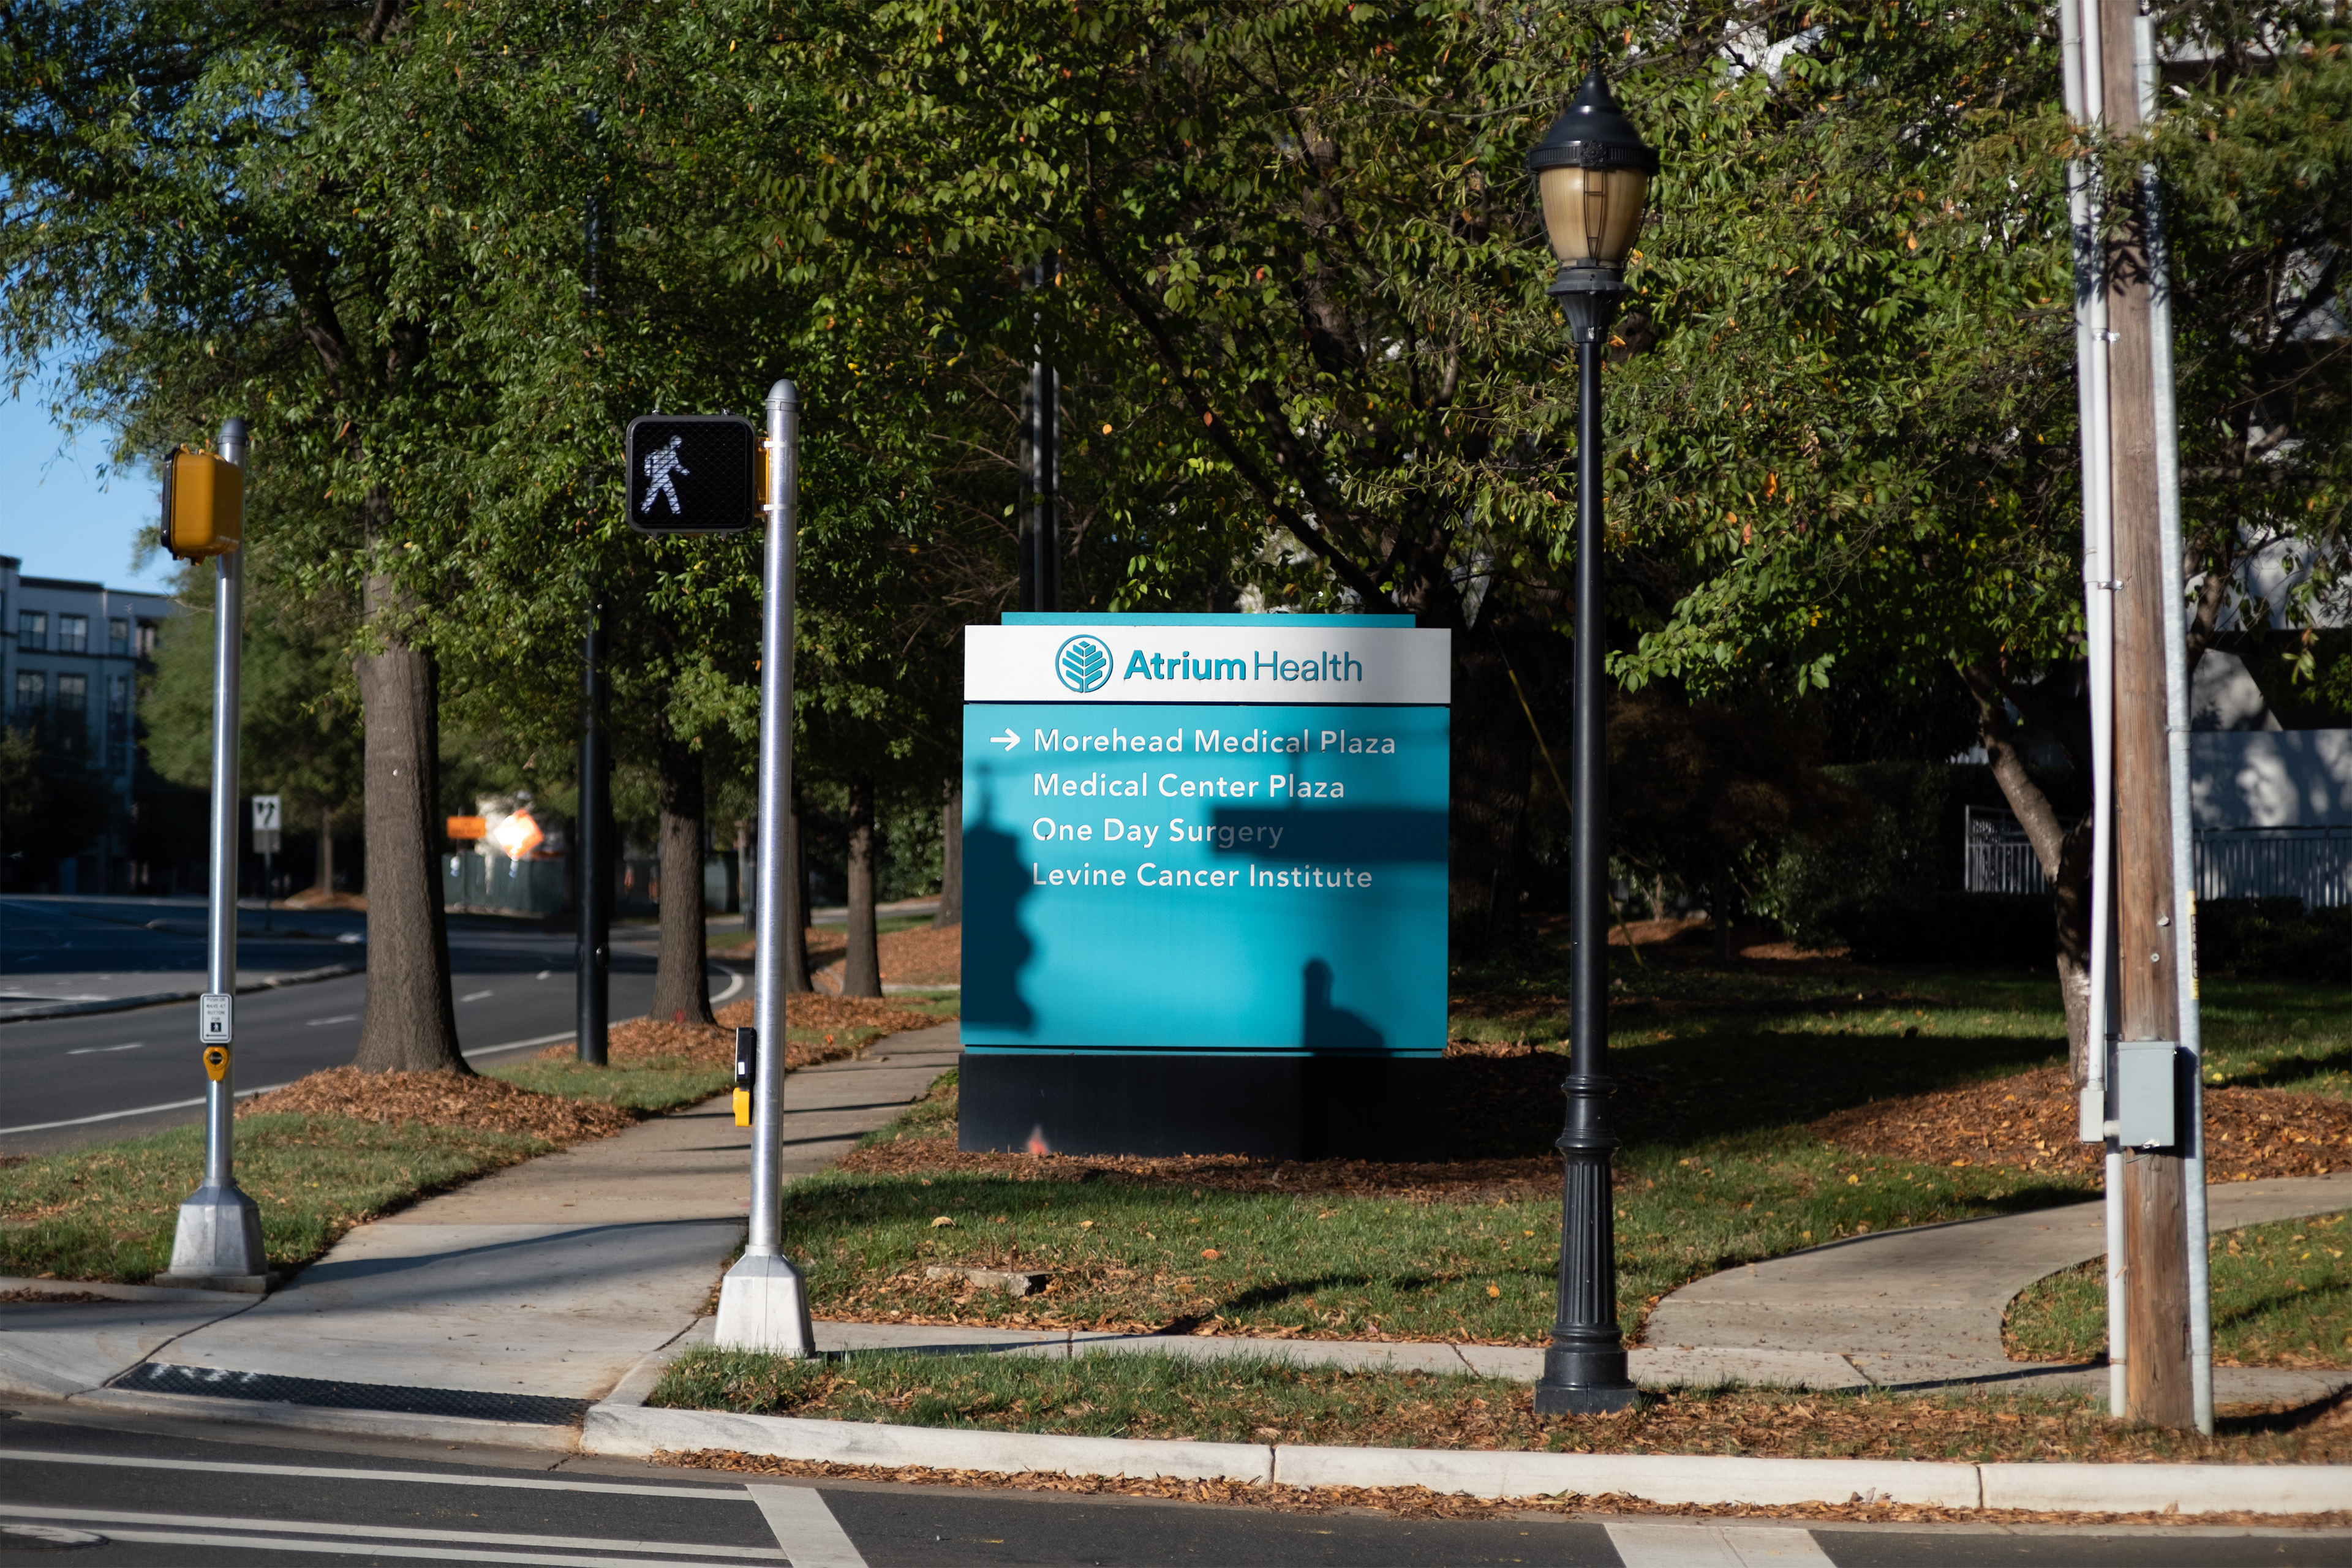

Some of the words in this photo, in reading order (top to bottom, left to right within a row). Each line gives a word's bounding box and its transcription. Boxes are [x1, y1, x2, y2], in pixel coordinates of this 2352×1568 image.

[1124, 650, 1246, 680] Atrium
[1254, 650, 1363, 682] Health
[1034, 728, 1183, 753] Morehead
[1195, 728, 1308, 753] Medical
[1321, 729, 1396, 754] Plaza
[1033, 772, 1147, 797] Medical
[1158, 774, 1259, 798] Center
[1270, 774, 1345, 799] Plaza
[1032, 817, 1093, 842] One
[1104, 818, 1159, 849] Day
[1169, 818, 1284, 850] Surgery
[1033, 862, 1126, 886] Levine
[1137, 863, 1240, 888] Cancer
[1250, 864, 1373, 889] Institute
